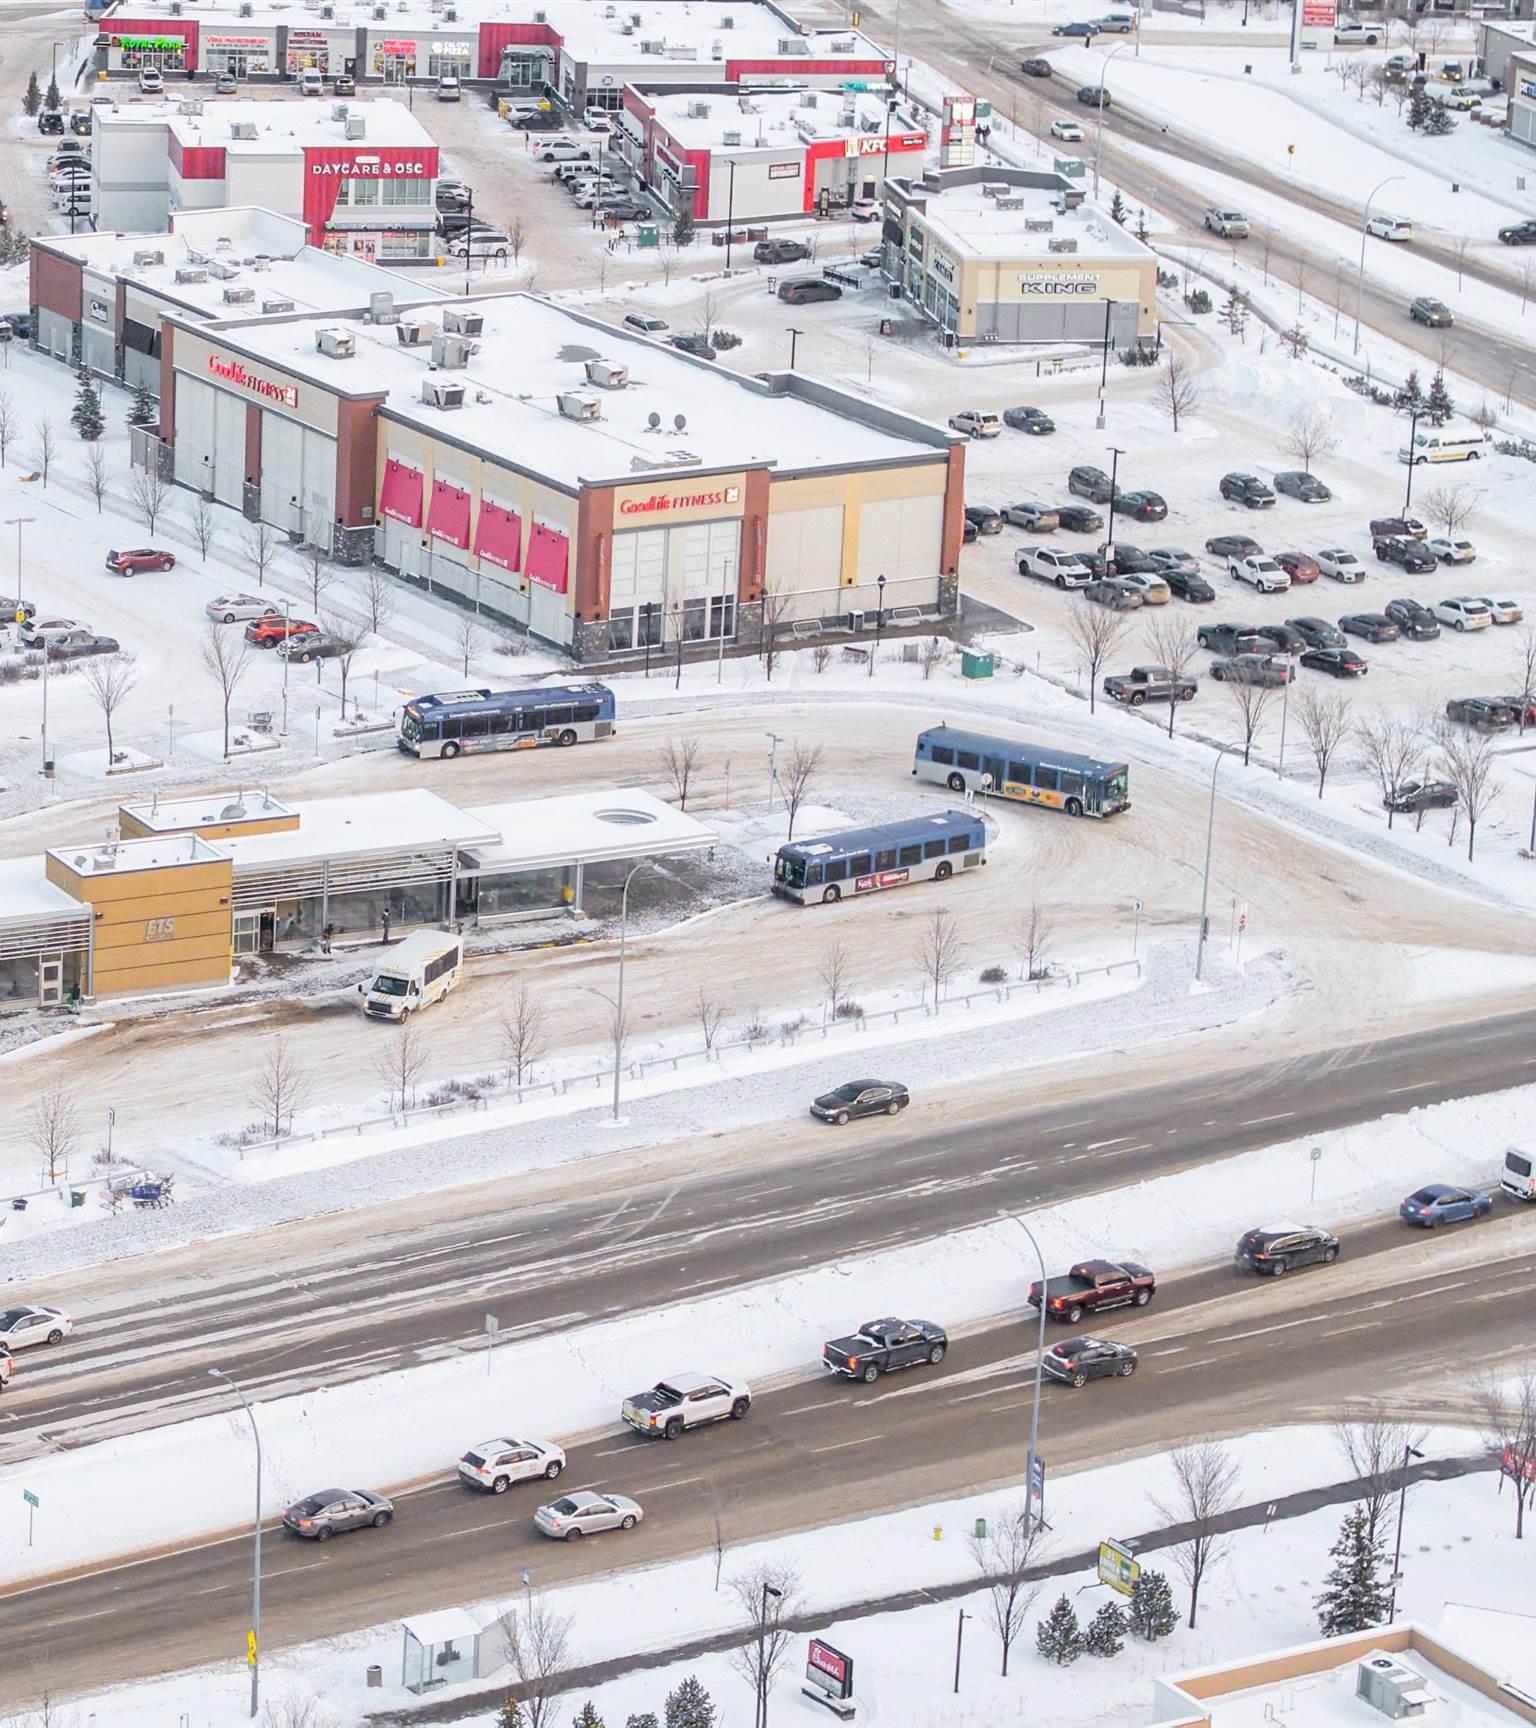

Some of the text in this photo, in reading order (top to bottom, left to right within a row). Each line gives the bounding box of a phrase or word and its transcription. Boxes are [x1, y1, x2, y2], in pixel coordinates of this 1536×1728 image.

[860, 139, 888, 154] KFC
[312, 162, 423, 175] DAYCARE & OSC
[1018, 272, 1101, 281] SUPPLEMENT
[1021, 282, 1097, 294] KING
[672, 492, 722, 509] FITNESS
[146, 918, 174, 934] ETS
